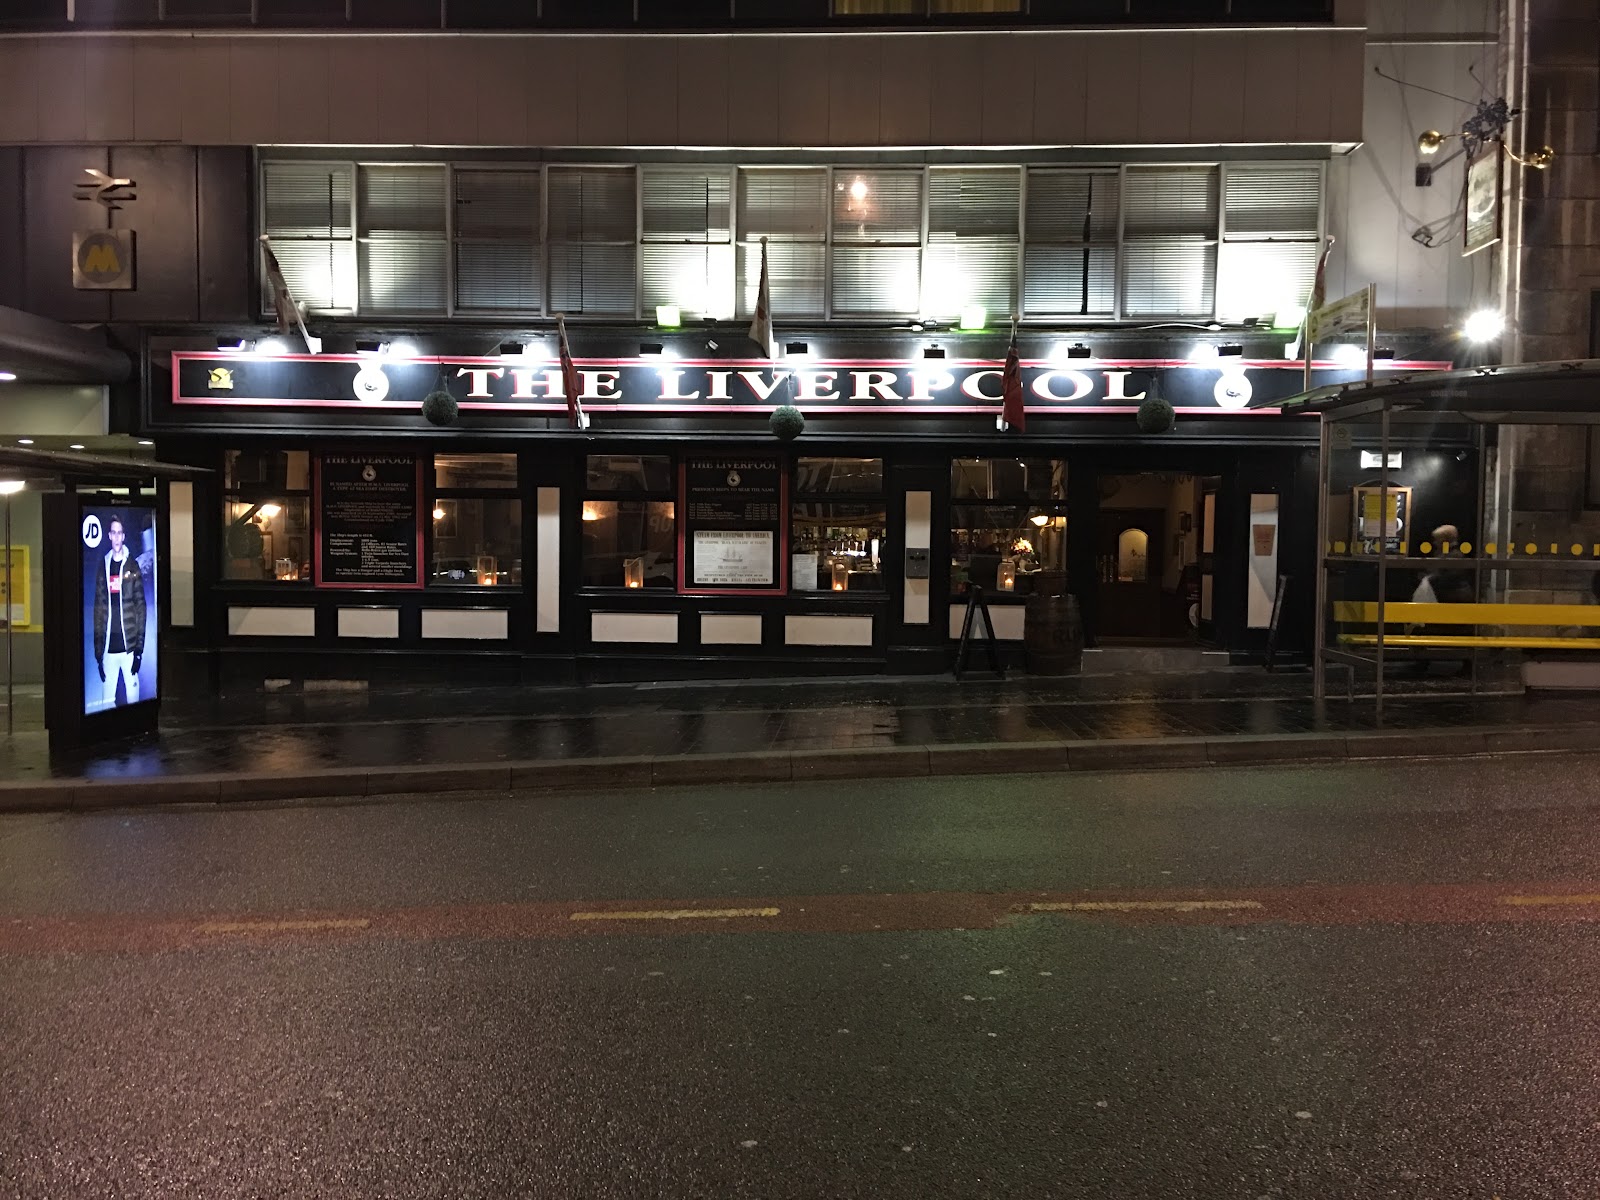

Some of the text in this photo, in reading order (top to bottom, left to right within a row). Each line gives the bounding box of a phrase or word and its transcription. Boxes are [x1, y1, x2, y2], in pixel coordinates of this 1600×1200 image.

[455, 367, 1147, 401] THE LIVERPOOL
[85, 523, 99, 539] JD
